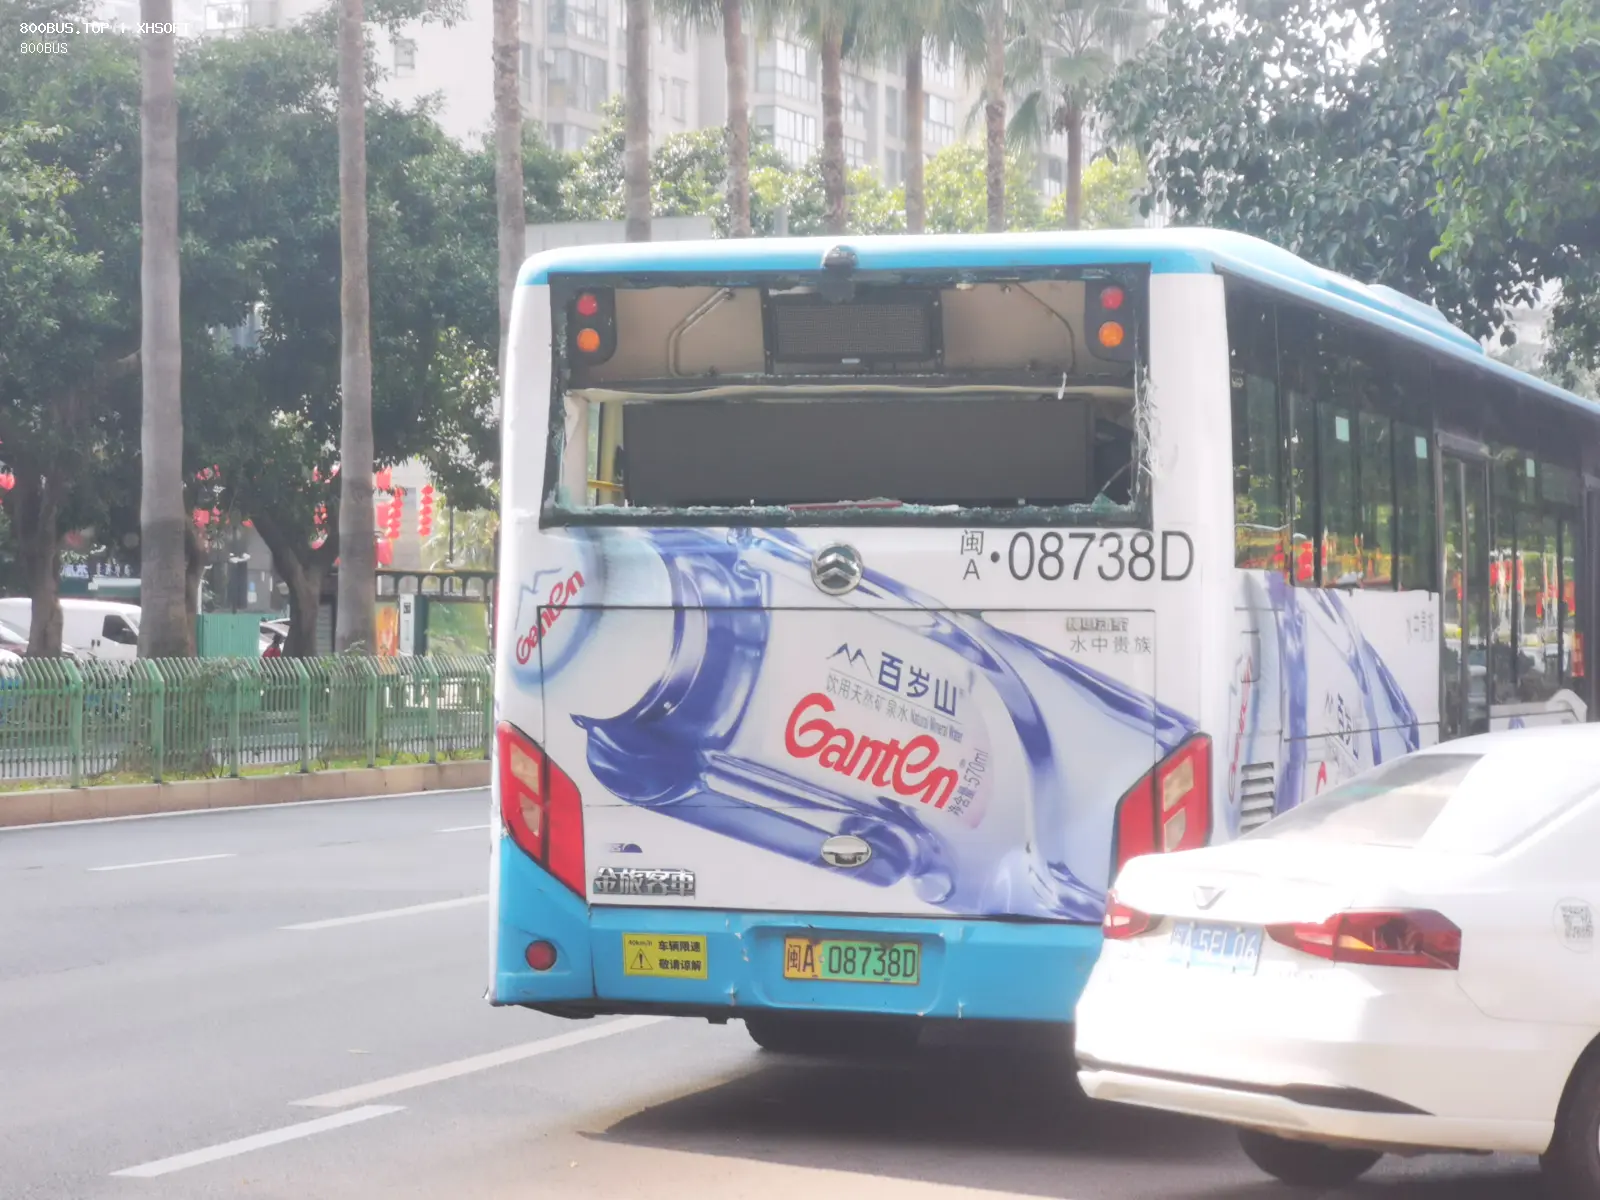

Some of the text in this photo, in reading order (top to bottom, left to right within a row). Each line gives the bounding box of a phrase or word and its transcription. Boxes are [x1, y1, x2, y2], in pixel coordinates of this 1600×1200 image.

[1069, 634, 1152, 655] 水中贵族
[878, 651, 958, 717] 百岁山
[784, 692, 959, 809] Ganten
[657, 939, 701, 953] 车辆限速
[658, 958, 702, 972] 敬请谅解
[828, 945, 917, 978] 08738D
